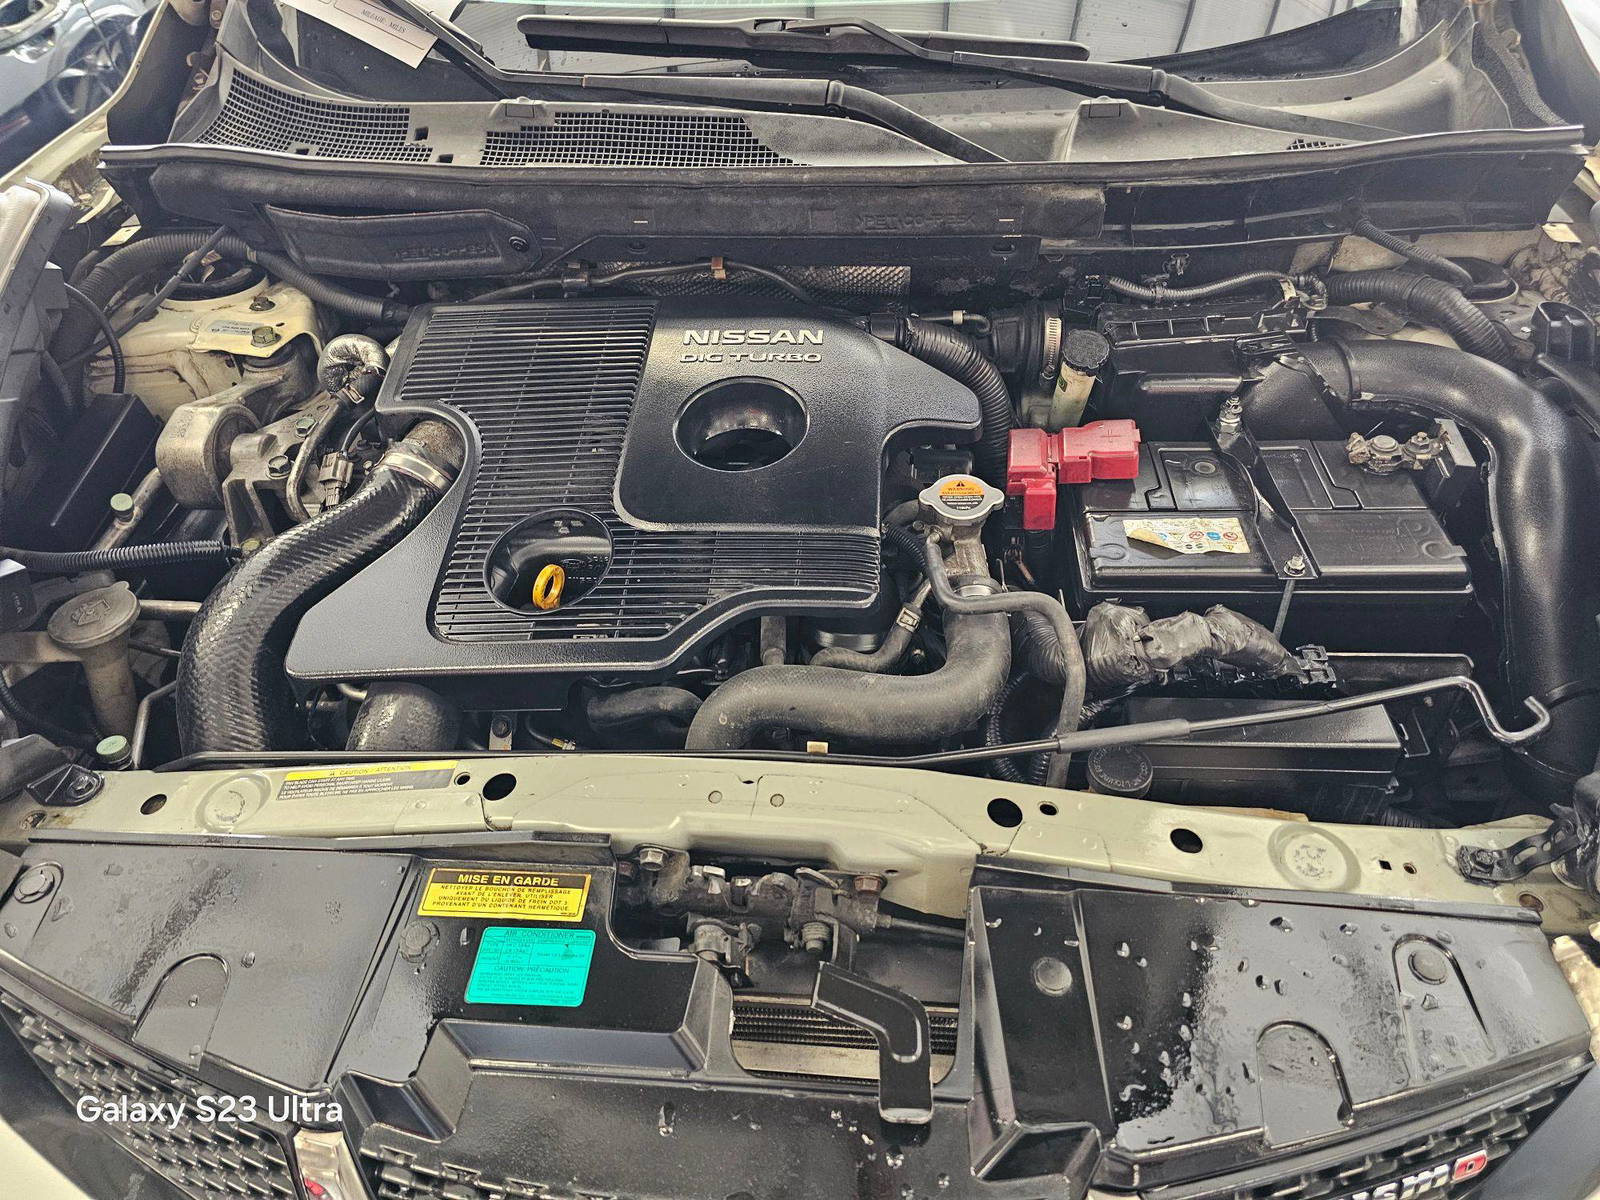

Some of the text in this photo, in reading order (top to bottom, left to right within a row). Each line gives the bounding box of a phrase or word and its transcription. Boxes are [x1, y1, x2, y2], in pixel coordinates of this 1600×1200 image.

[683, 329, 824, 345] NISSAN
[680, 353, 822, 362] DIG TURBO
[458, 874, 559, 888] MISE EN GARDE
